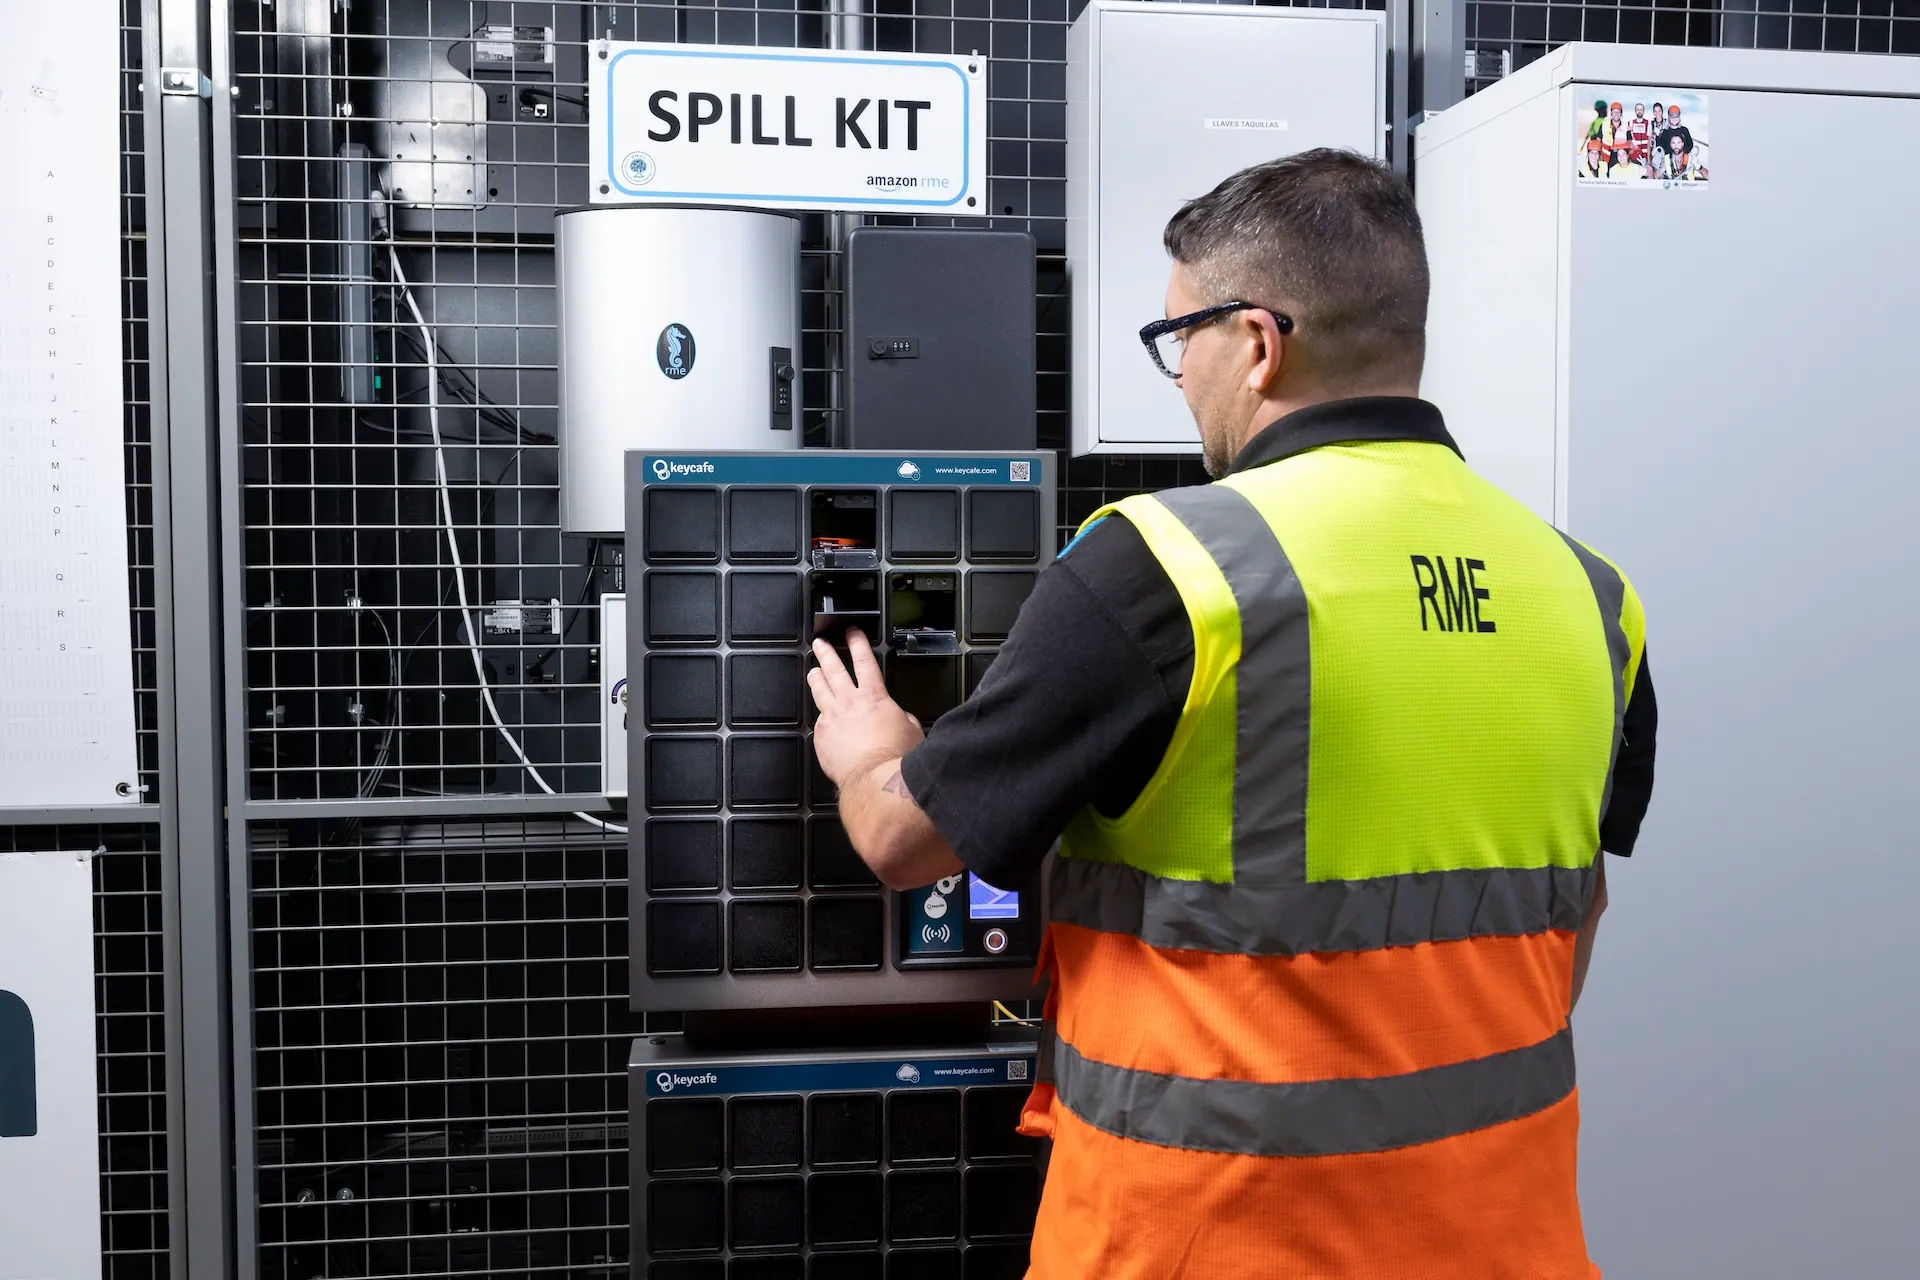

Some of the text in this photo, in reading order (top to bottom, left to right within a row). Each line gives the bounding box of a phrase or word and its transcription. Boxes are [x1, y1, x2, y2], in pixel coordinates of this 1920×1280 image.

[648, 90, 932, 151] SPILL KIT
[1212, 120, 1279, 129] LLAVES TAQUILLAS
[867, 174, 950, 189] amazon rme
[665, 366, 687, 376] rme
[670, 460, 997, 476] keycafe www.keycafe.com
[1409, 554, 1497, 633] RME
[674, 1067, 995, 1087] keycafe www.keycafe.com
